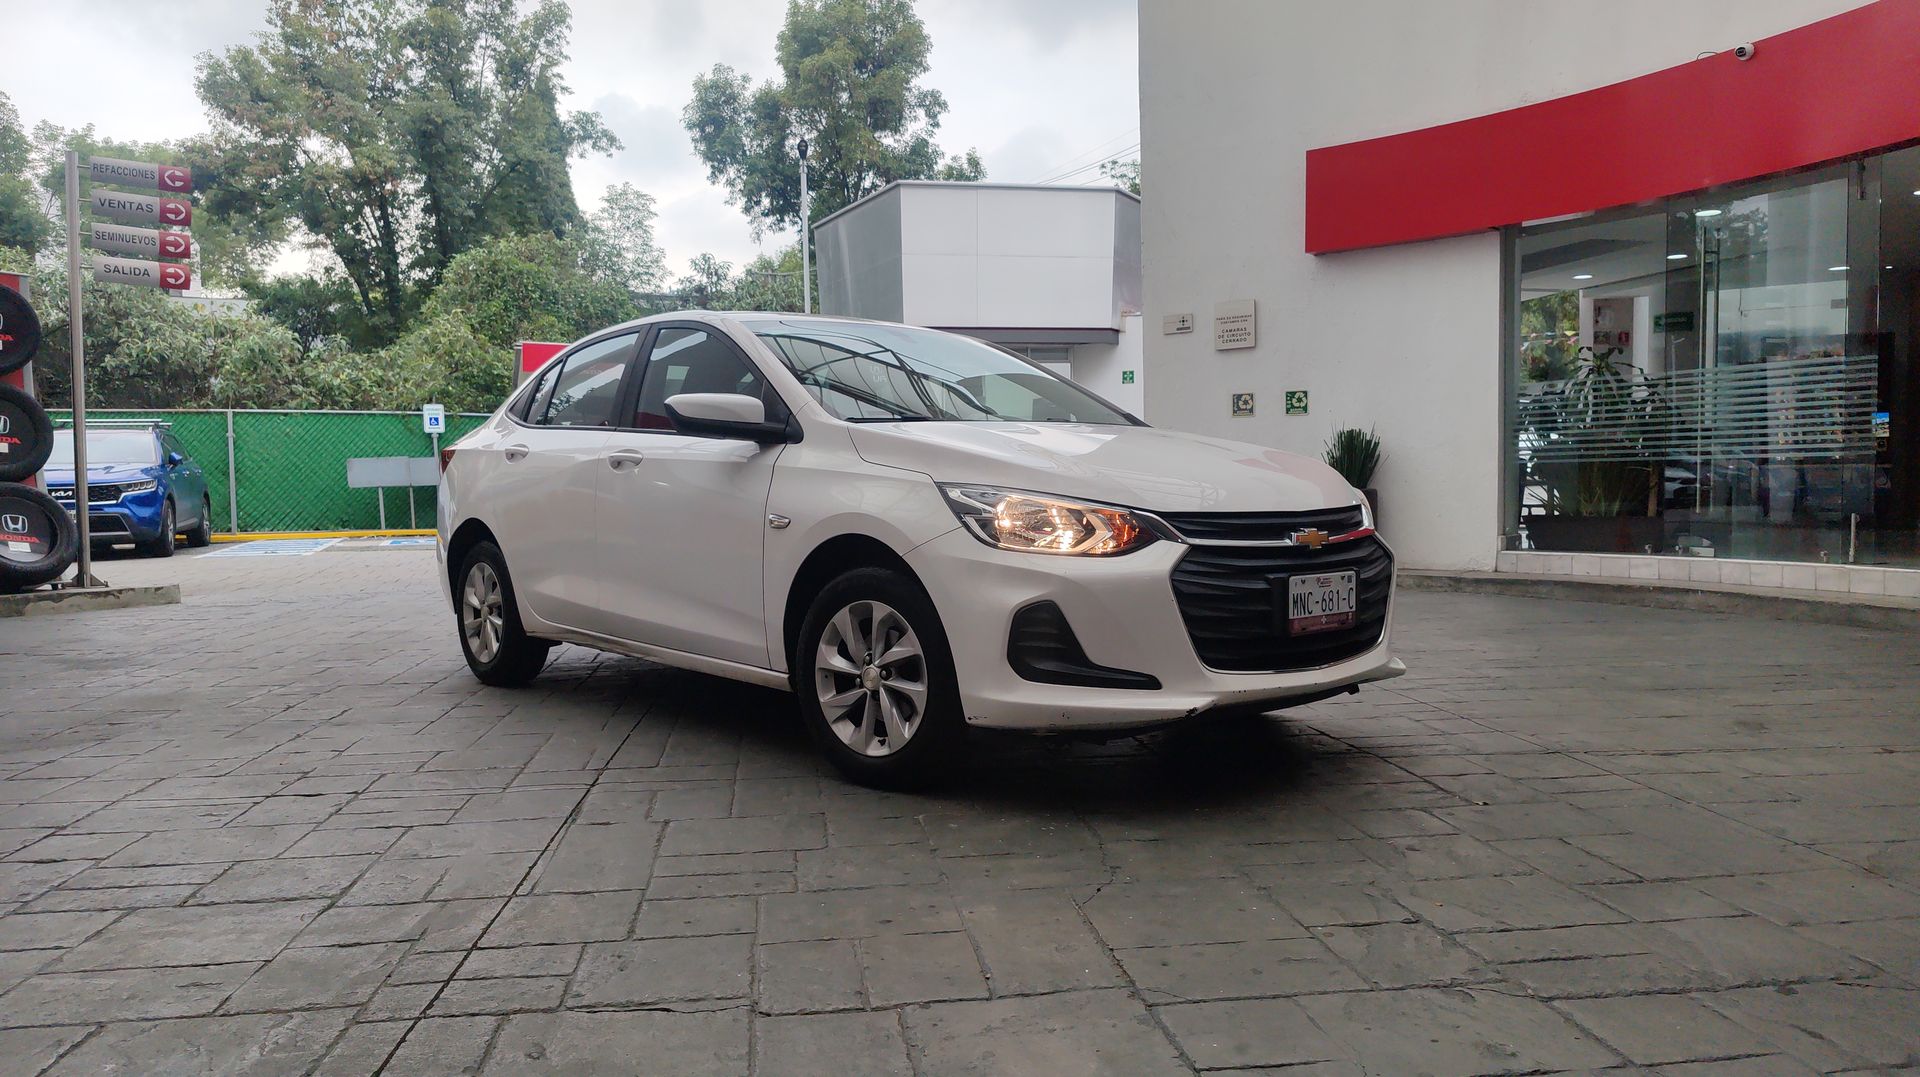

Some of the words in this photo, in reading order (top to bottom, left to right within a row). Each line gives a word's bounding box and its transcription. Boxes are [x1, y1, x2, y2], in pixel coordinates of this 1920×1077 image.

[93, 163, 156, 180] REFACCIONES
[98, 198, 154, 214] VENTAS
[95, 230, 157, 246] SEMINUEVOS
[103, 263, 151, 278] SALIDA
[1292, 587, 1354, 617] MNC-681-C
